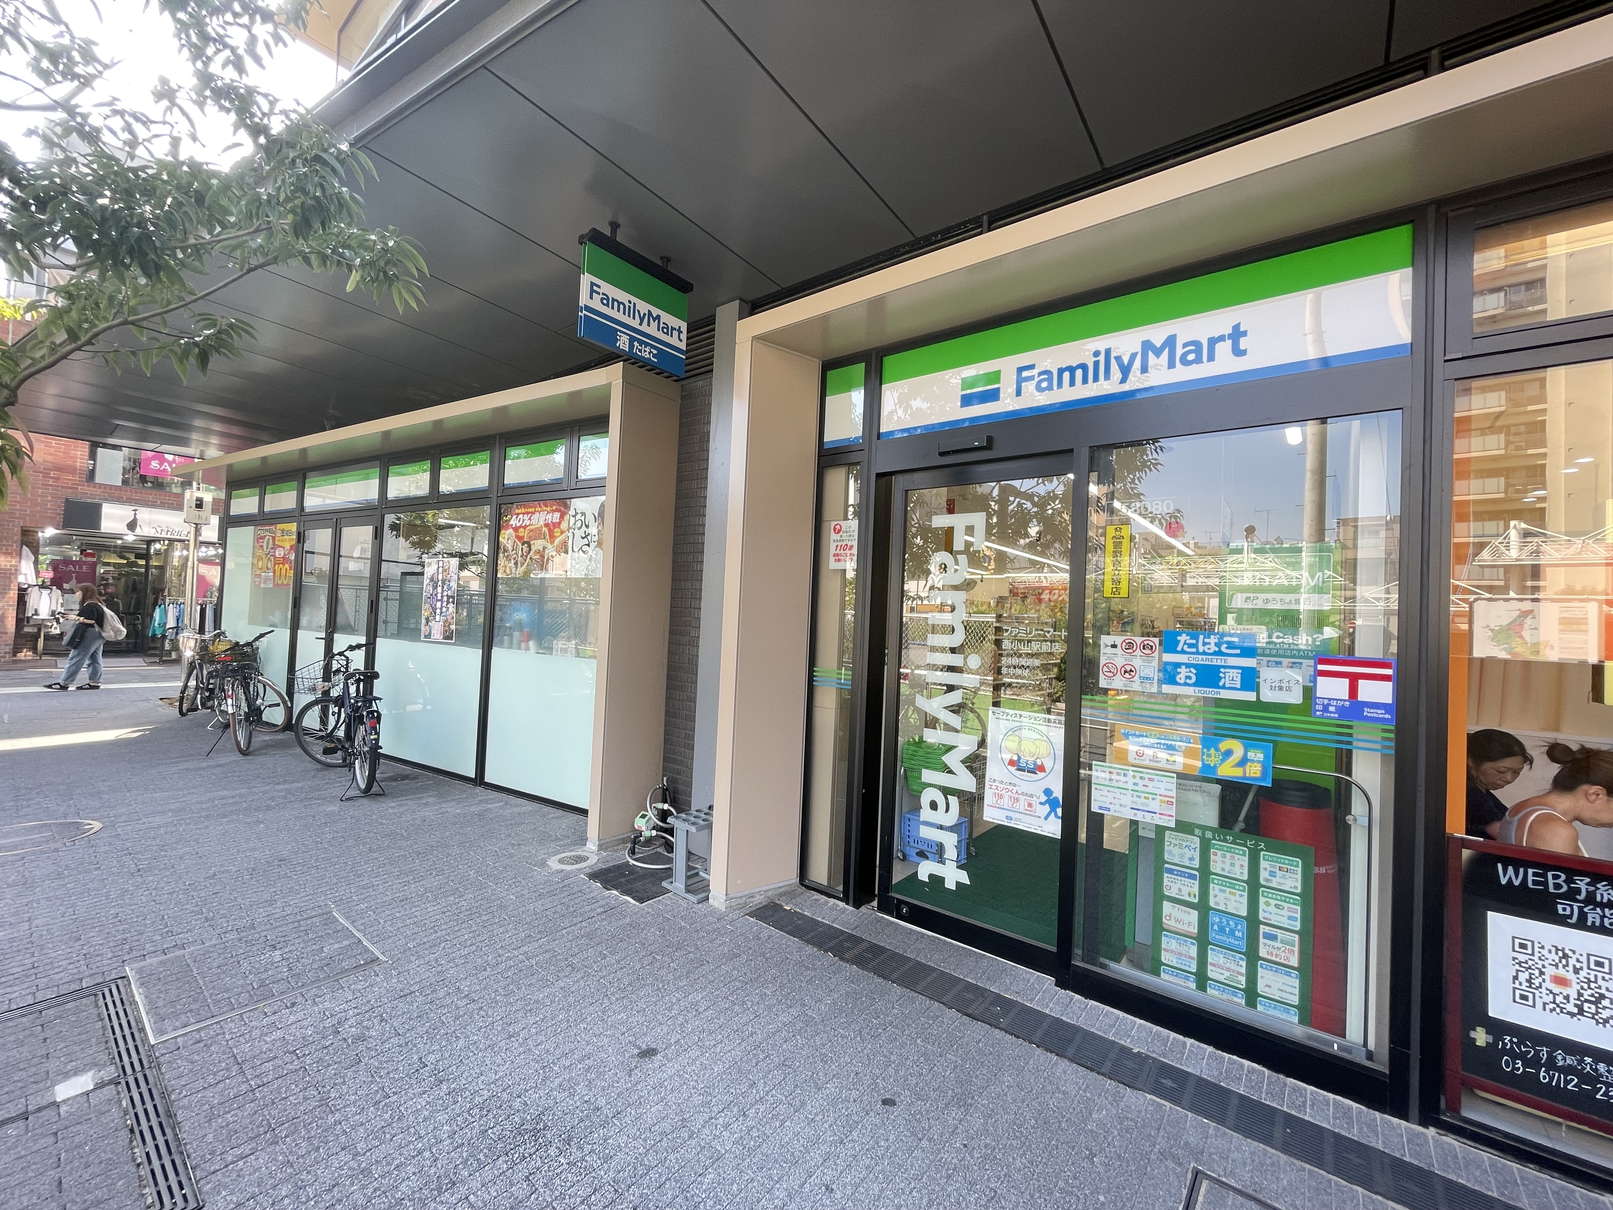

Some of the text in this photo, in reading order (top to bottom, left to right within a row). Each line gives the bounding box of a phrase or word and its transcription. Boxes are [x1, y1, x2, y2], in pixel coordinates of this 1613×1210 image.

[589, 281, 683, 343] FamilyMart
[616, 331, 658, 362] 酒 たばこ
[1015, 321, 1248, 397] FamilyMart
[58, 564, 90, 573] SALE
[1002, 625, 1068, 641] ファミリーマート
[1176, 632, 1241, 655] たばこ
[1187, 656, 1229, 665] CIGARETTE
[915, 511, 987, 891] FamilyMart
[1193, 688, 1222, 698] LIQUOR
[1018, 759, 1036, 769] SS
